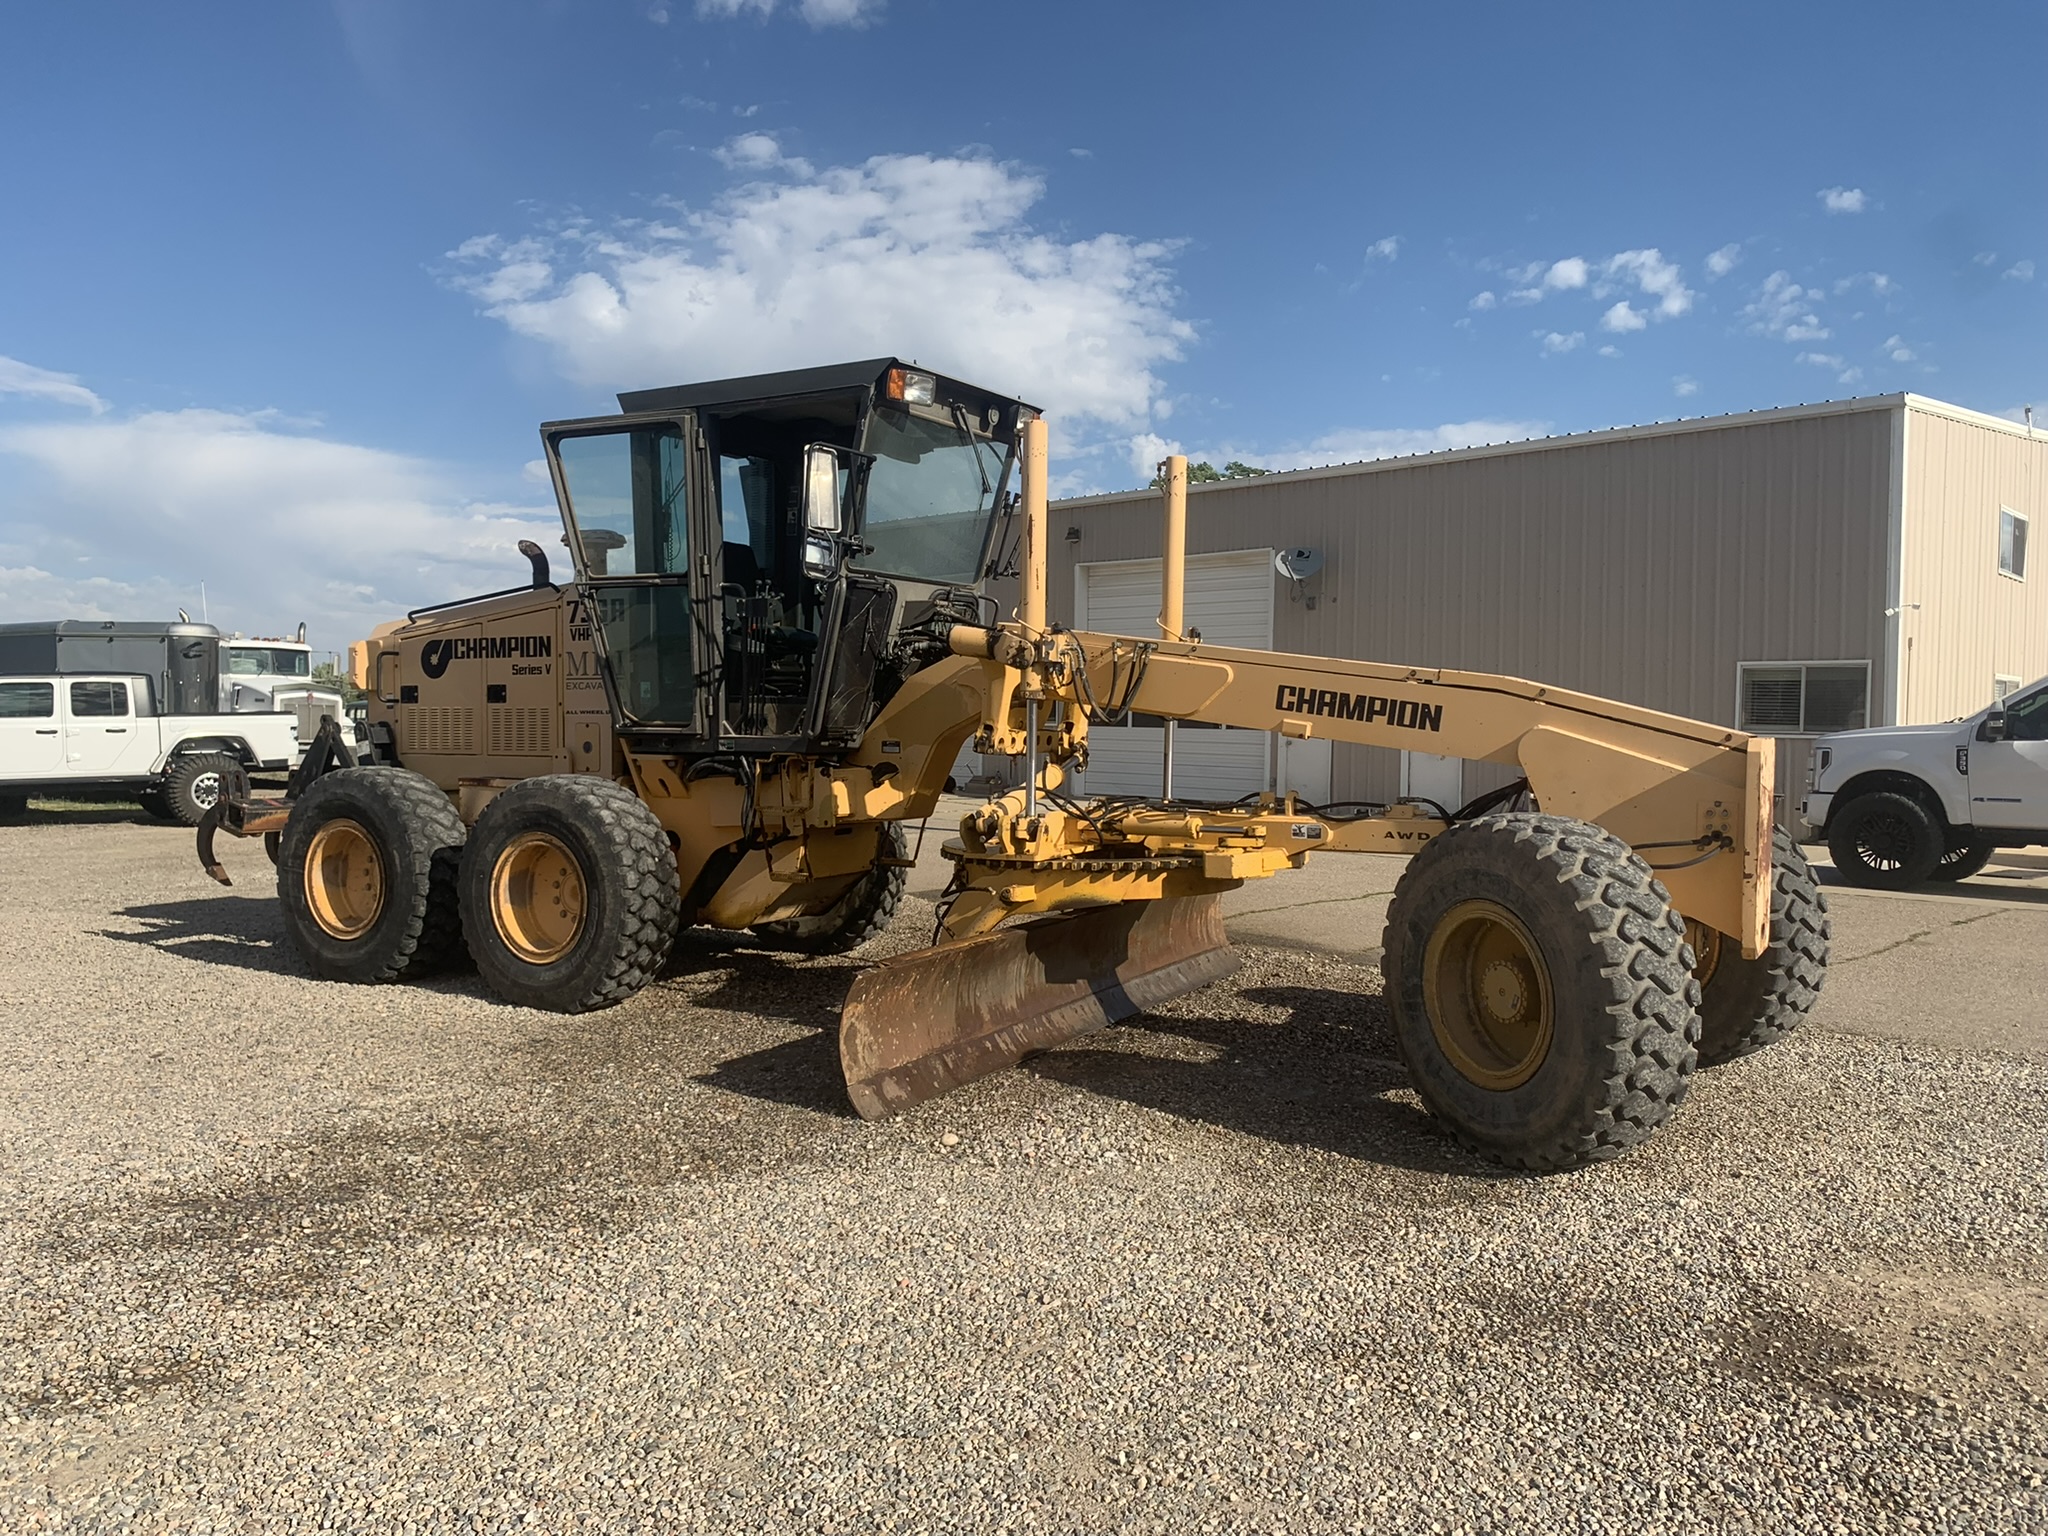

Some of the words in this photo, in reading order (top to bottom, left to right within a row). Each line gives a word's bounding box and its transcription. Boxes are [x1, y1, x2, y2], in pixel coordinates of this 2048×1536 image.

[453, 635, 552, 660] CHAMPION
[511, 663, 543, 676] Series
[545, 663, 552, 675] V
[1275, 684, 1443, 732] CHAMPION
[1383, 830, 1431, 841] AWD
